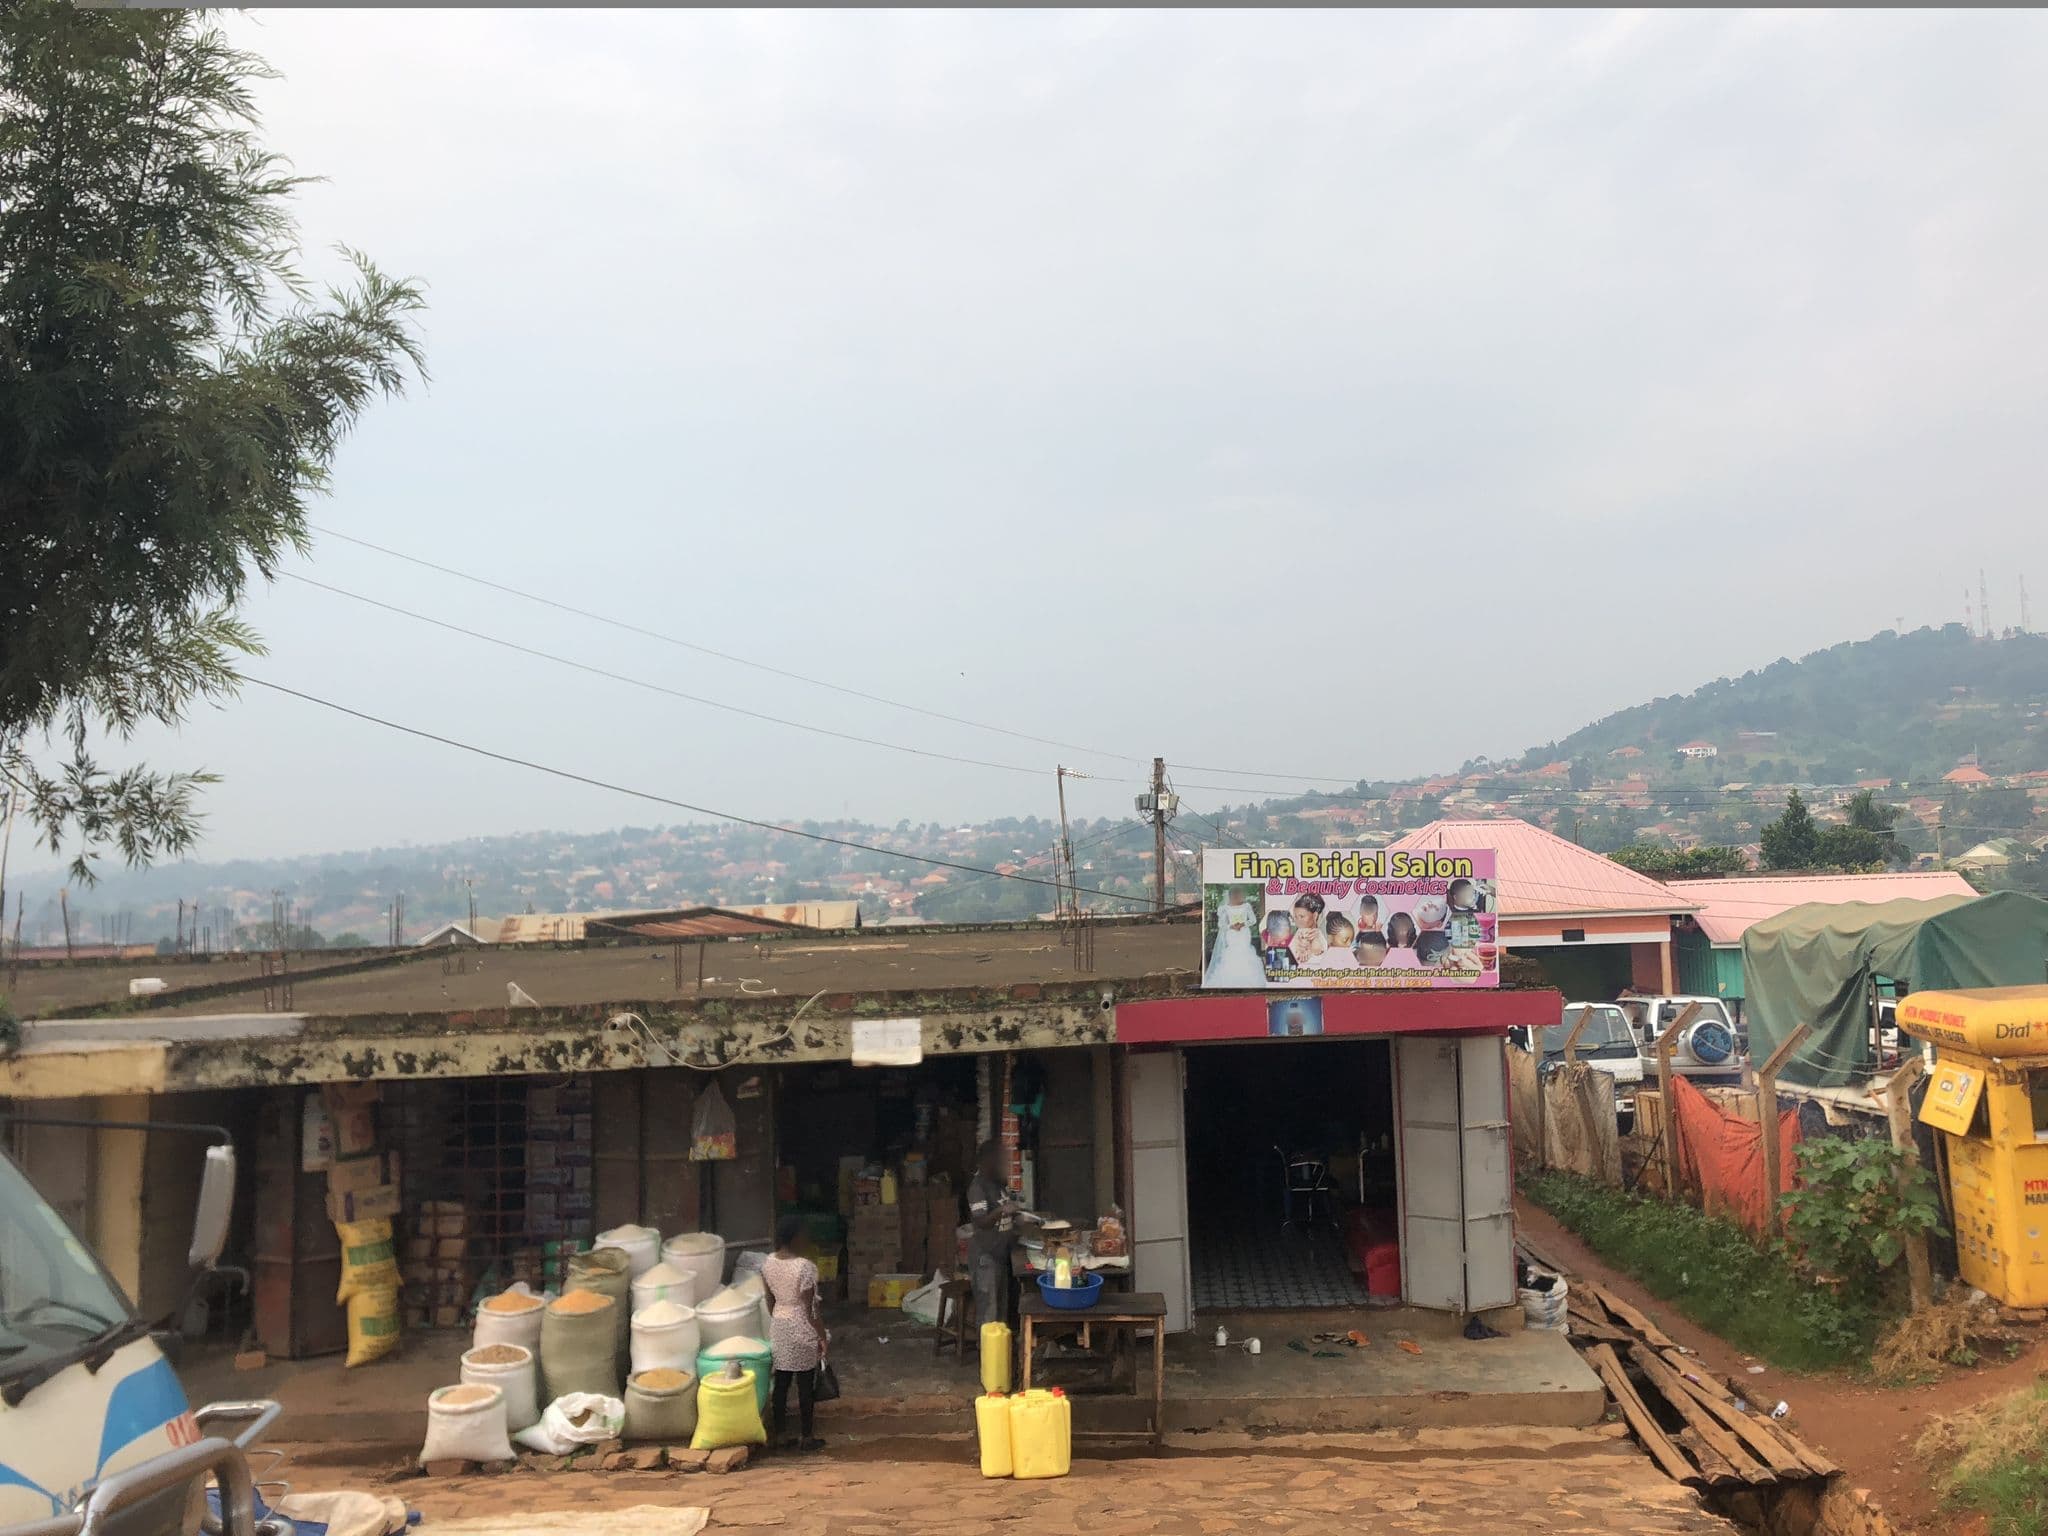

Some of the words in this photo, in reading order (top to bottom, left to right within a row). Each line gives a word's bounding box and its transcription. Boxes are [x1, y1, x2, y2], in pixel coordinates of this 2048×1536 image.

[1234, 851, 1295, 878] Fina
[1300, 851, 1386, 878] Bridal
[1391, 850, 1473, 878] Salon
[1266, 878, 1283, 895] &
[1285, 878, 1352, 899] Beauty
[1353, 877, 1448, 896] Cosmetics
[1442, 967, 1480, 978] Manicure
[1996, 1021, 2031, 1039] Dial
